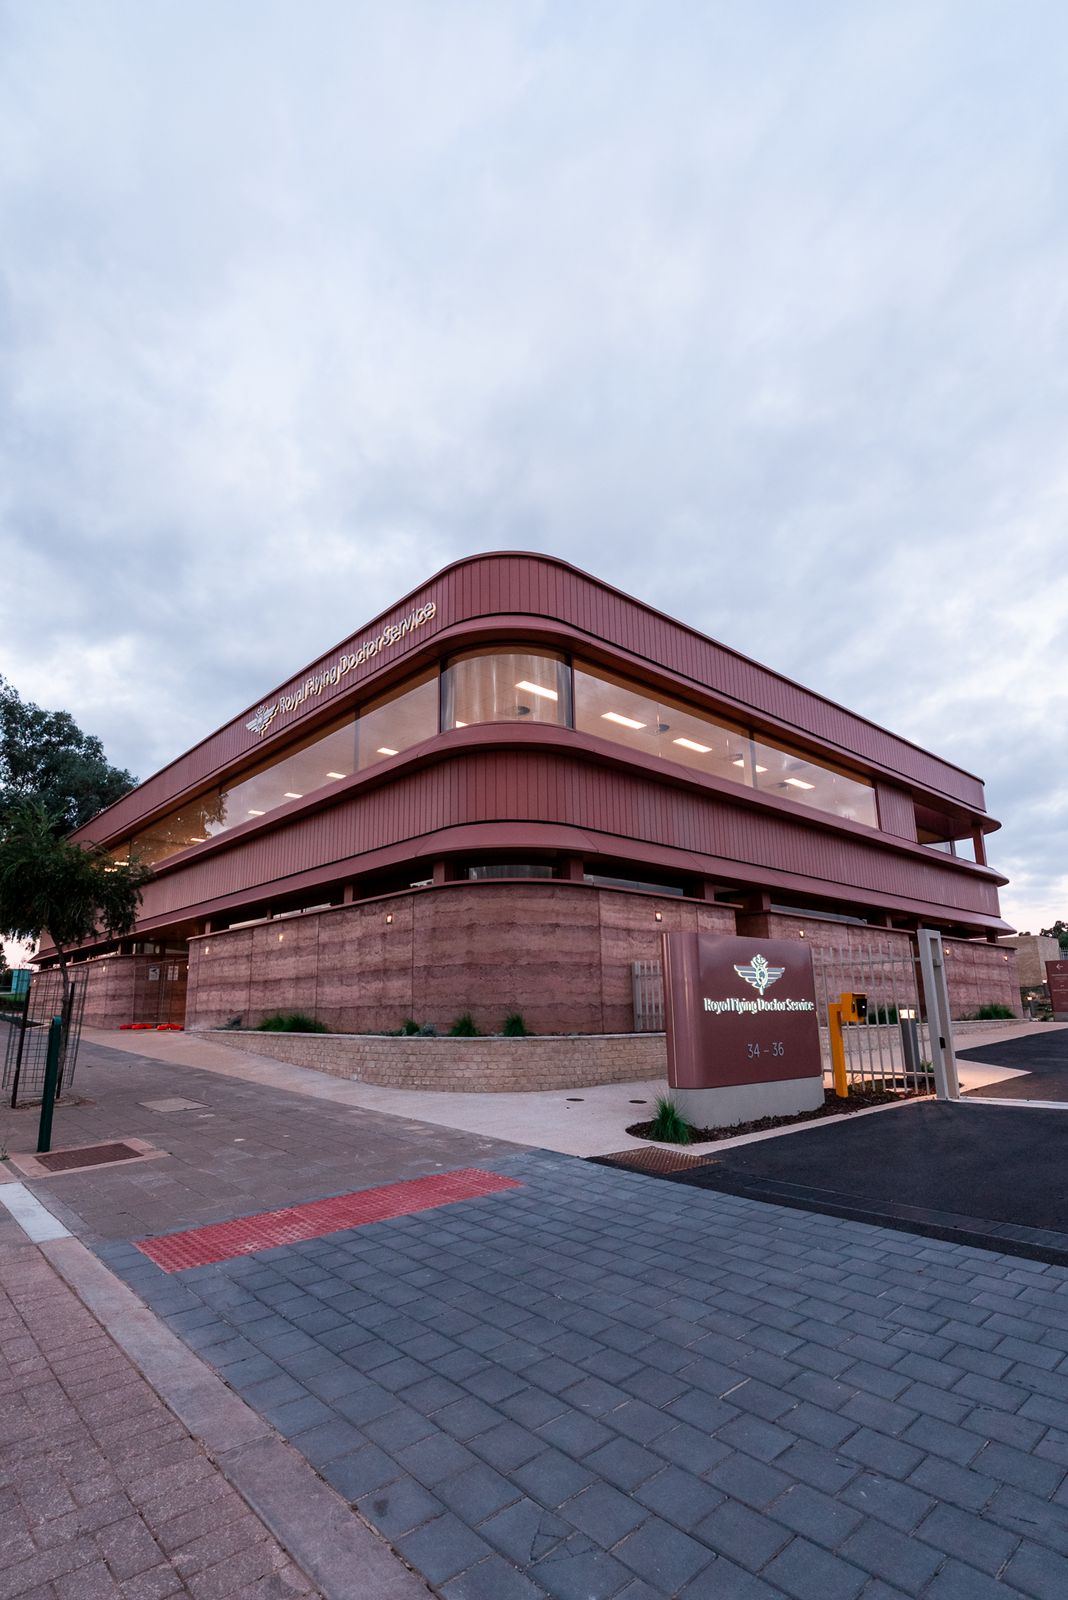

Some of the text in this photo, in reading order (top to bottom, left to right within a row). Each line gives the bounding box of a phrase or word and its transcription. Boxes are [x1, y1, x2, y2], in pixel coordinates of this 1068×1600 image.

[280, 602, 436, 714] Royal Flying Doctor Service
[703, 998, 815, 1015] Royal Flying Doctor Service
[747, 1043, 760, 1059] 34
[772, 1042, 785, 1057] 36
